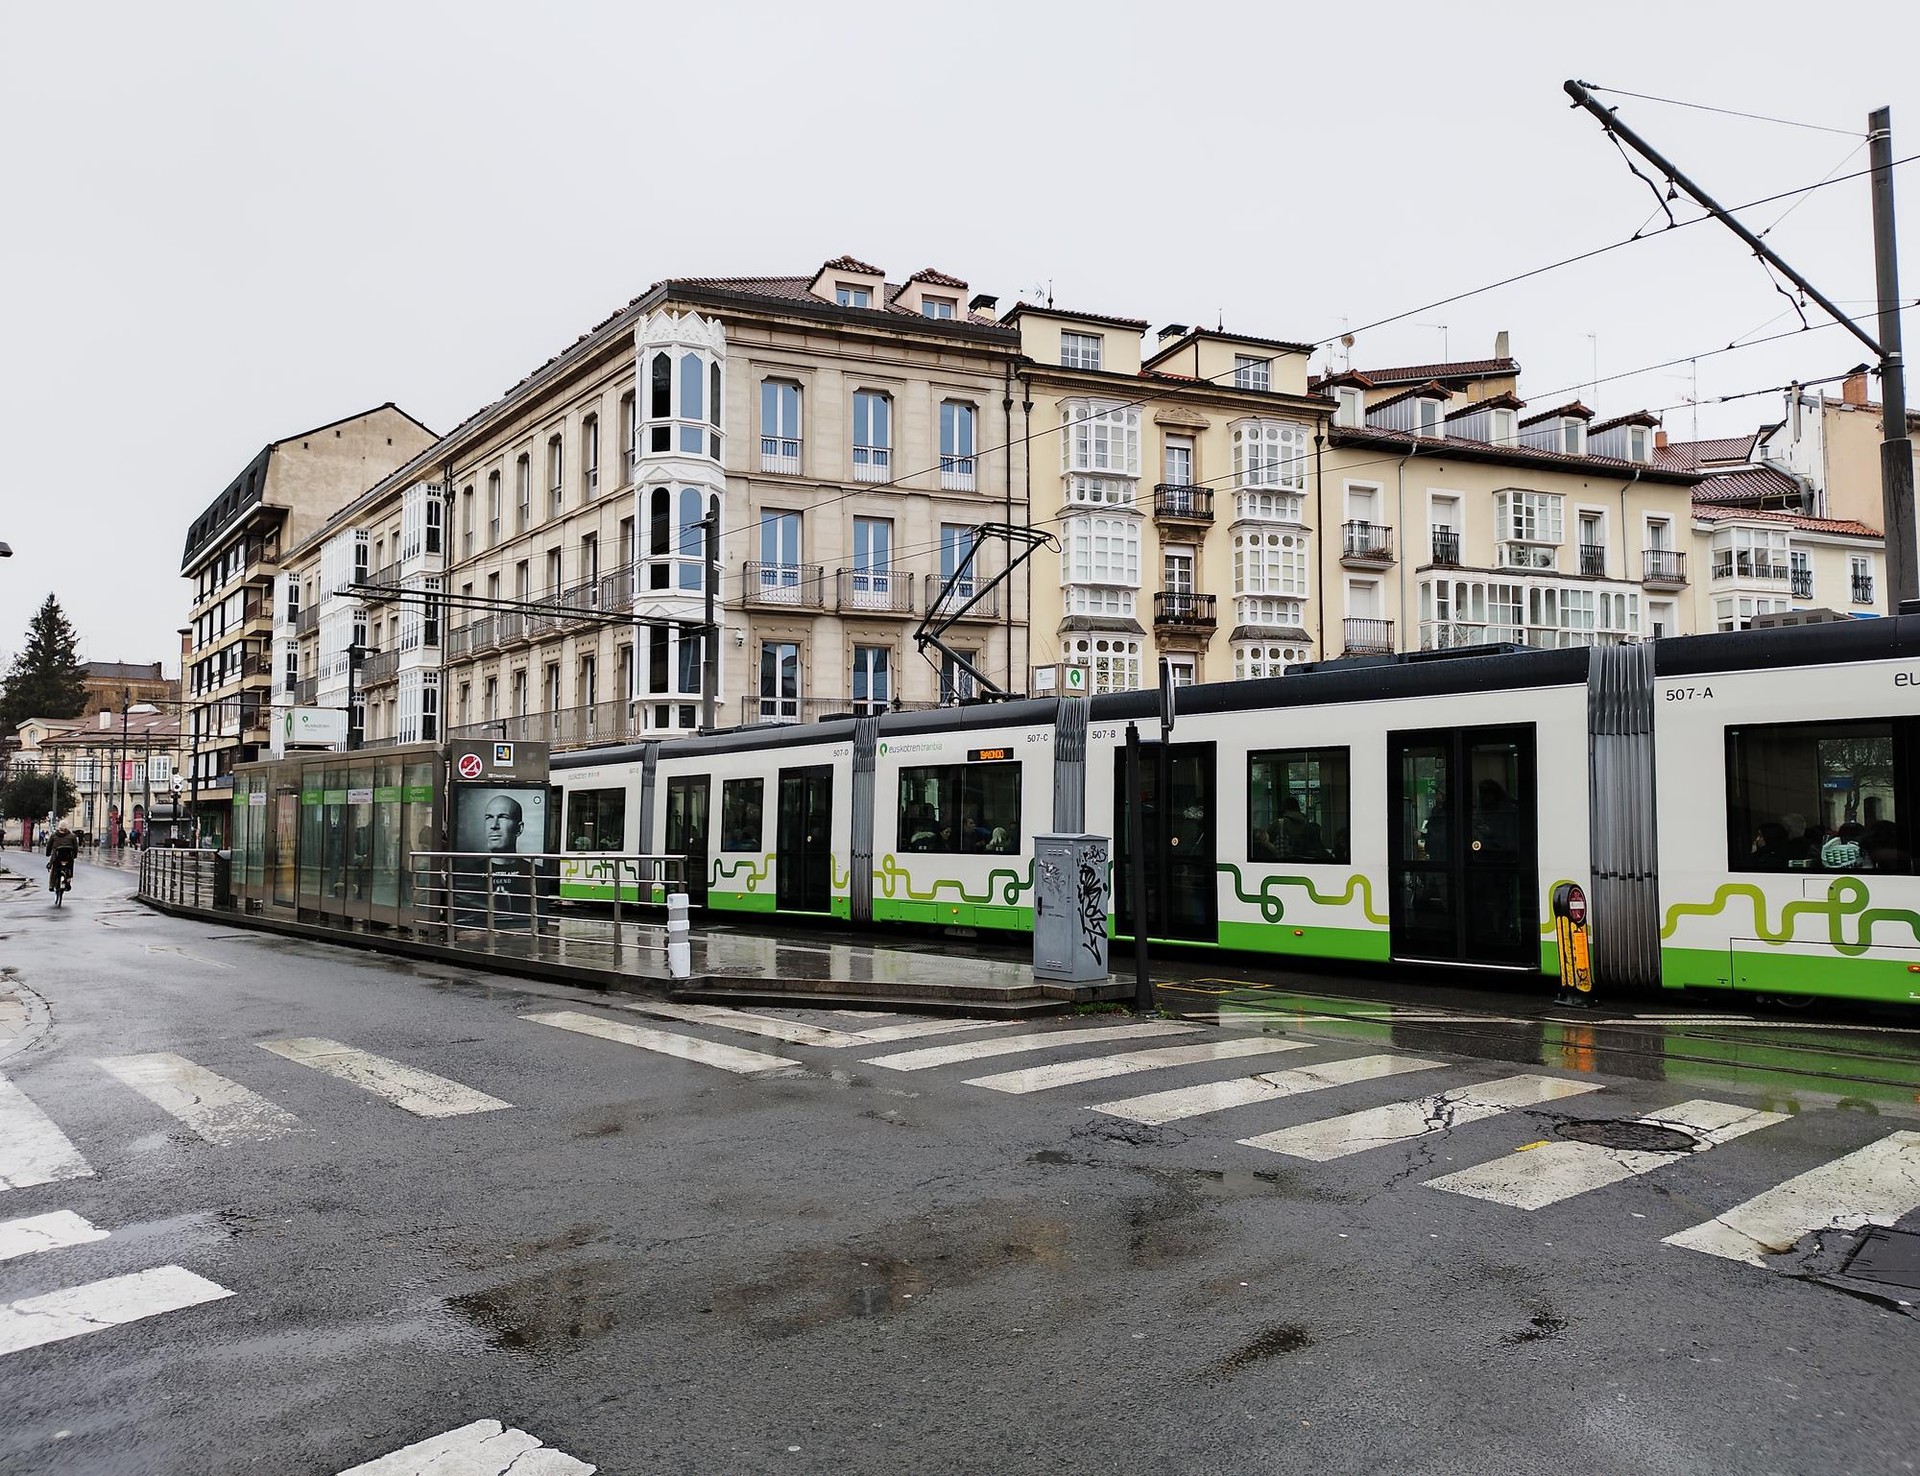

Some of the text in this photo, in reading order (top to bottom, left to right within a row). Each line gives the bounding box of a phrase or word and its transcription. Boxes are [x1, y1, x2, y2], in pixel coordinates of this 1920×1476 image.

[1666, 687, 1714, 701] 507-A
[1027, 733, 1049, 743] 507-C
[1092, 730, 1116, 739] 507-B
[833, 748, 849, 757] 507-D
